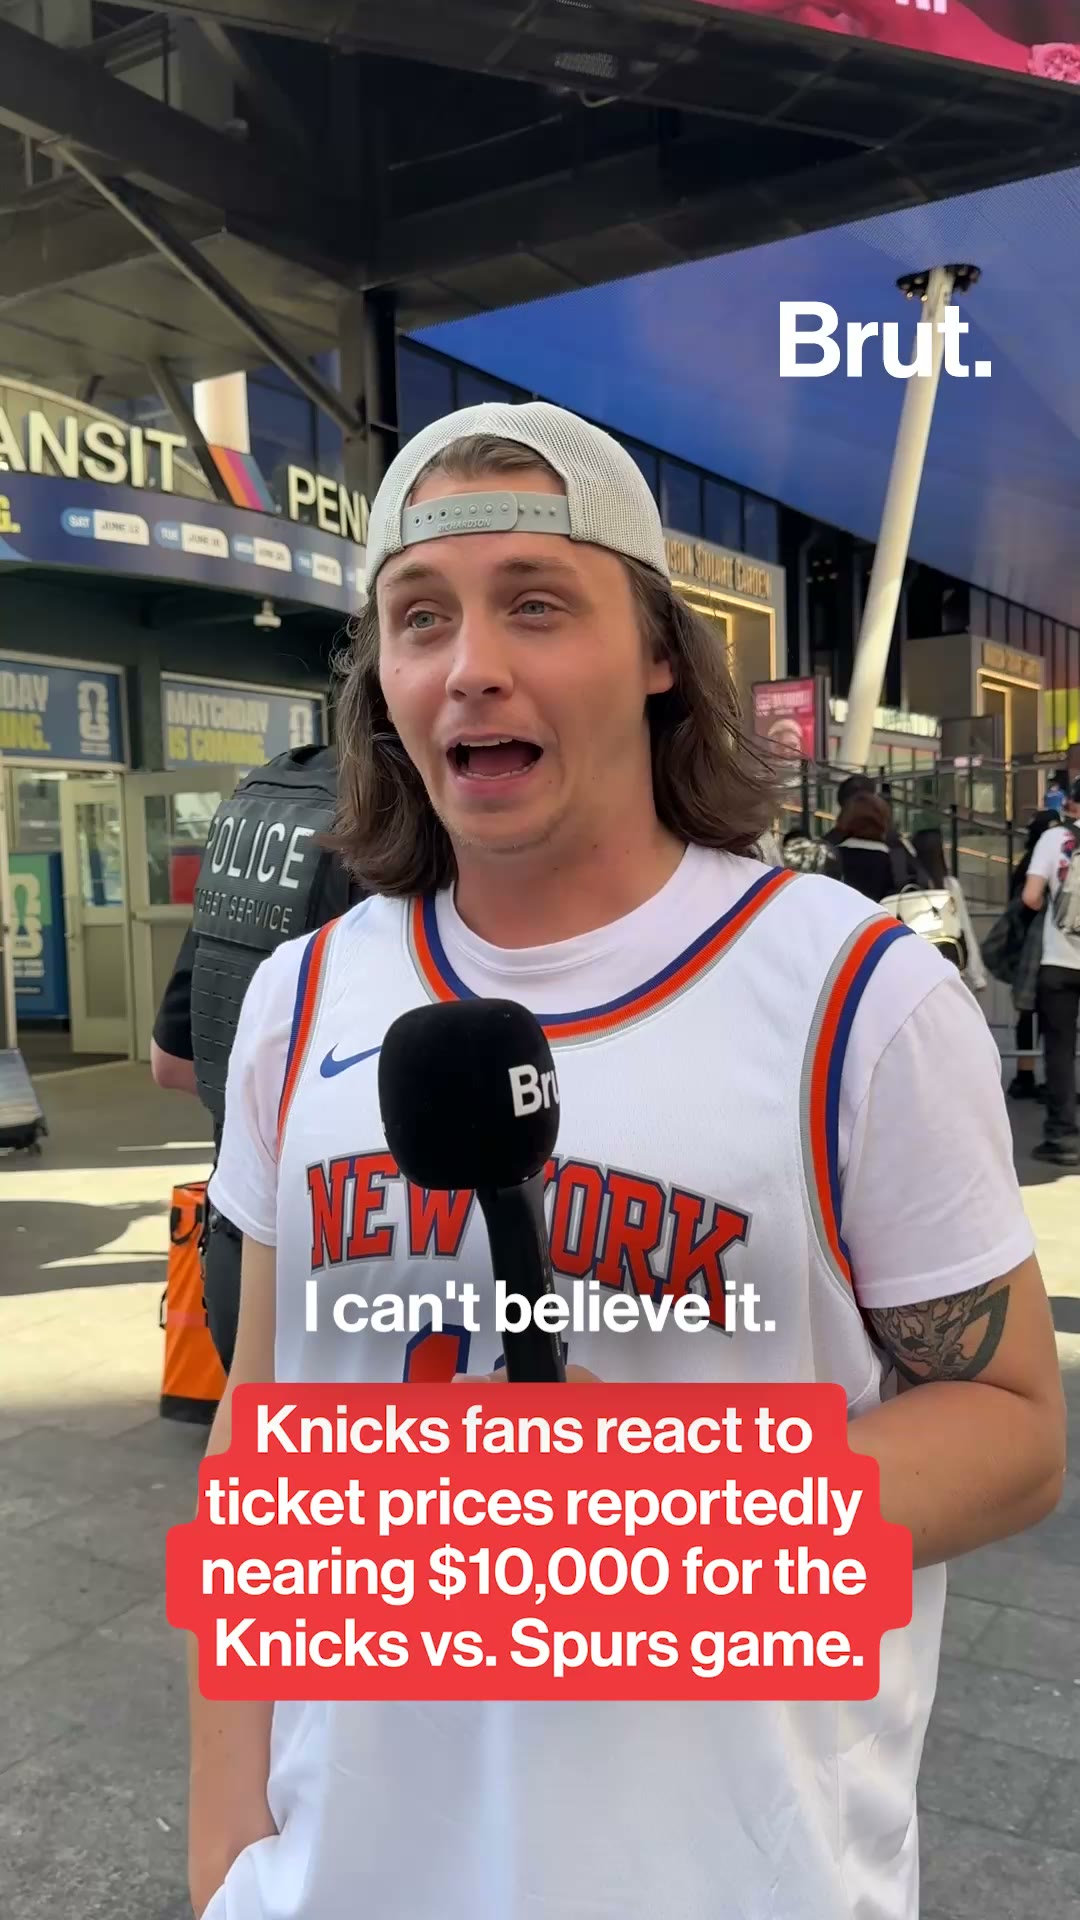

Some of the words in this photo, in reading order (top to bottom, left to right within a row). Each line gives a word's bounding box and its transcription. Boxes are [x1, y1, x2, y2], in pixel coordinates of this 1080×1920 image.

[166, 690, 269, 733] MATCHDAY
[227, 895, 292, 934] SERVICE
[306, 1148, 476, 1275] NEW
